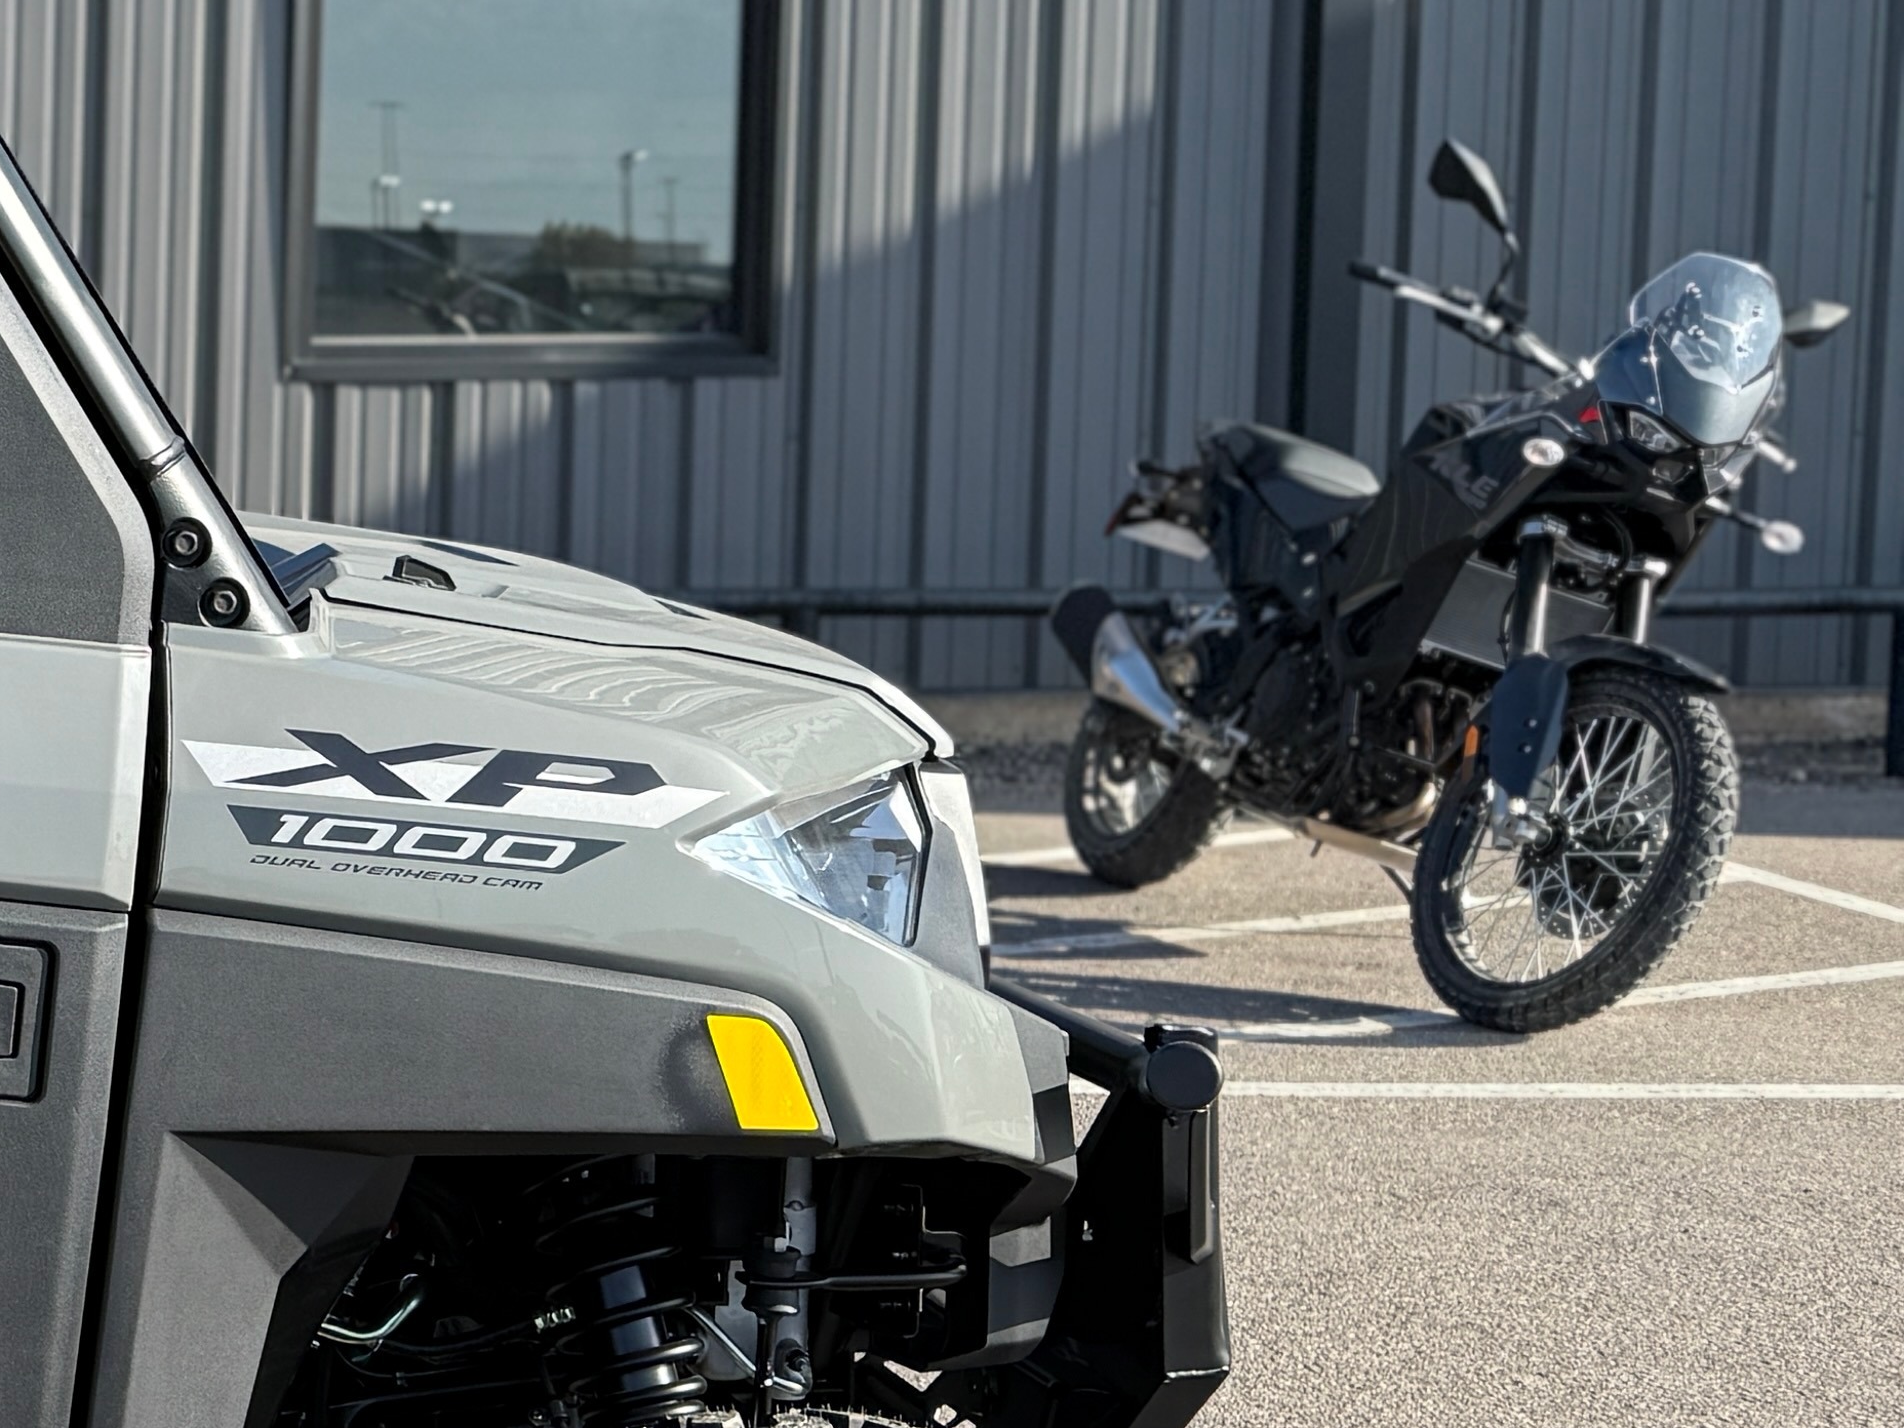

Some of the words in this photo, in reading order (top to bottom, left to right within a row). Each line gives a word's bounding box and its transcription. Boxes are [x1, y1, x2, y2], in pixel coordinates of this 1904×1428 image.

[224, 728, 671, 808] XP
[270, 811, 579, 871] 1000
[248, 854, 322, 870] DUAL
[329, 862, 479, 885] OVERHEAD
[481, 876, 544, 892] CAM
